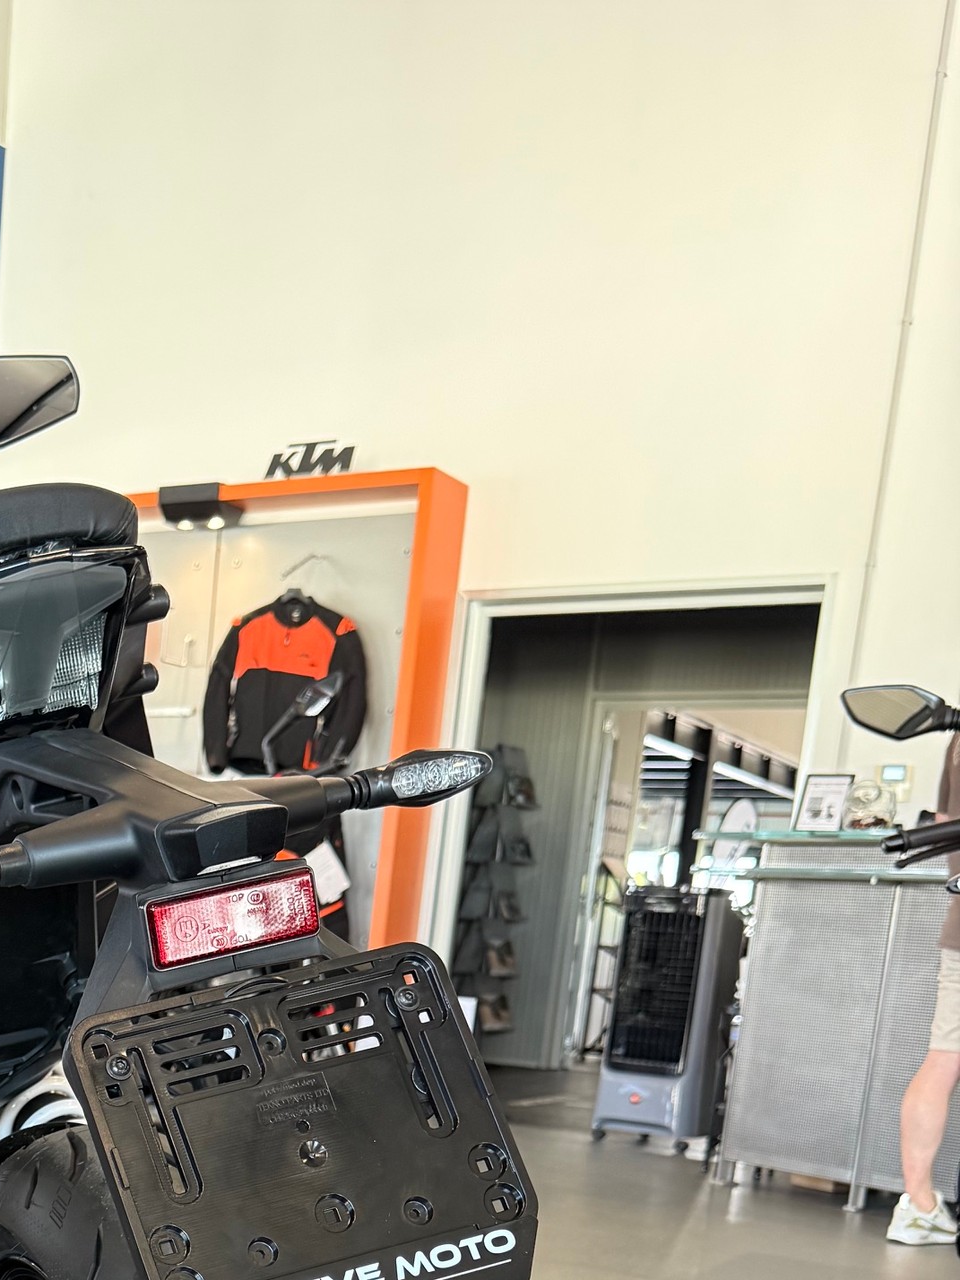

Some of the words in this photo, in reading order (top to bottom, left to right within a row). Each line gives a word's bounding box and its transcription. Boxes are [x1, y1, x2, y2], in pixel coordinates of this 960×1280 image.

[264, 440, 355, 479] KTM
[227, 893, 244, 904] TOP
[395, 1229, 516, 1280] MOTO
